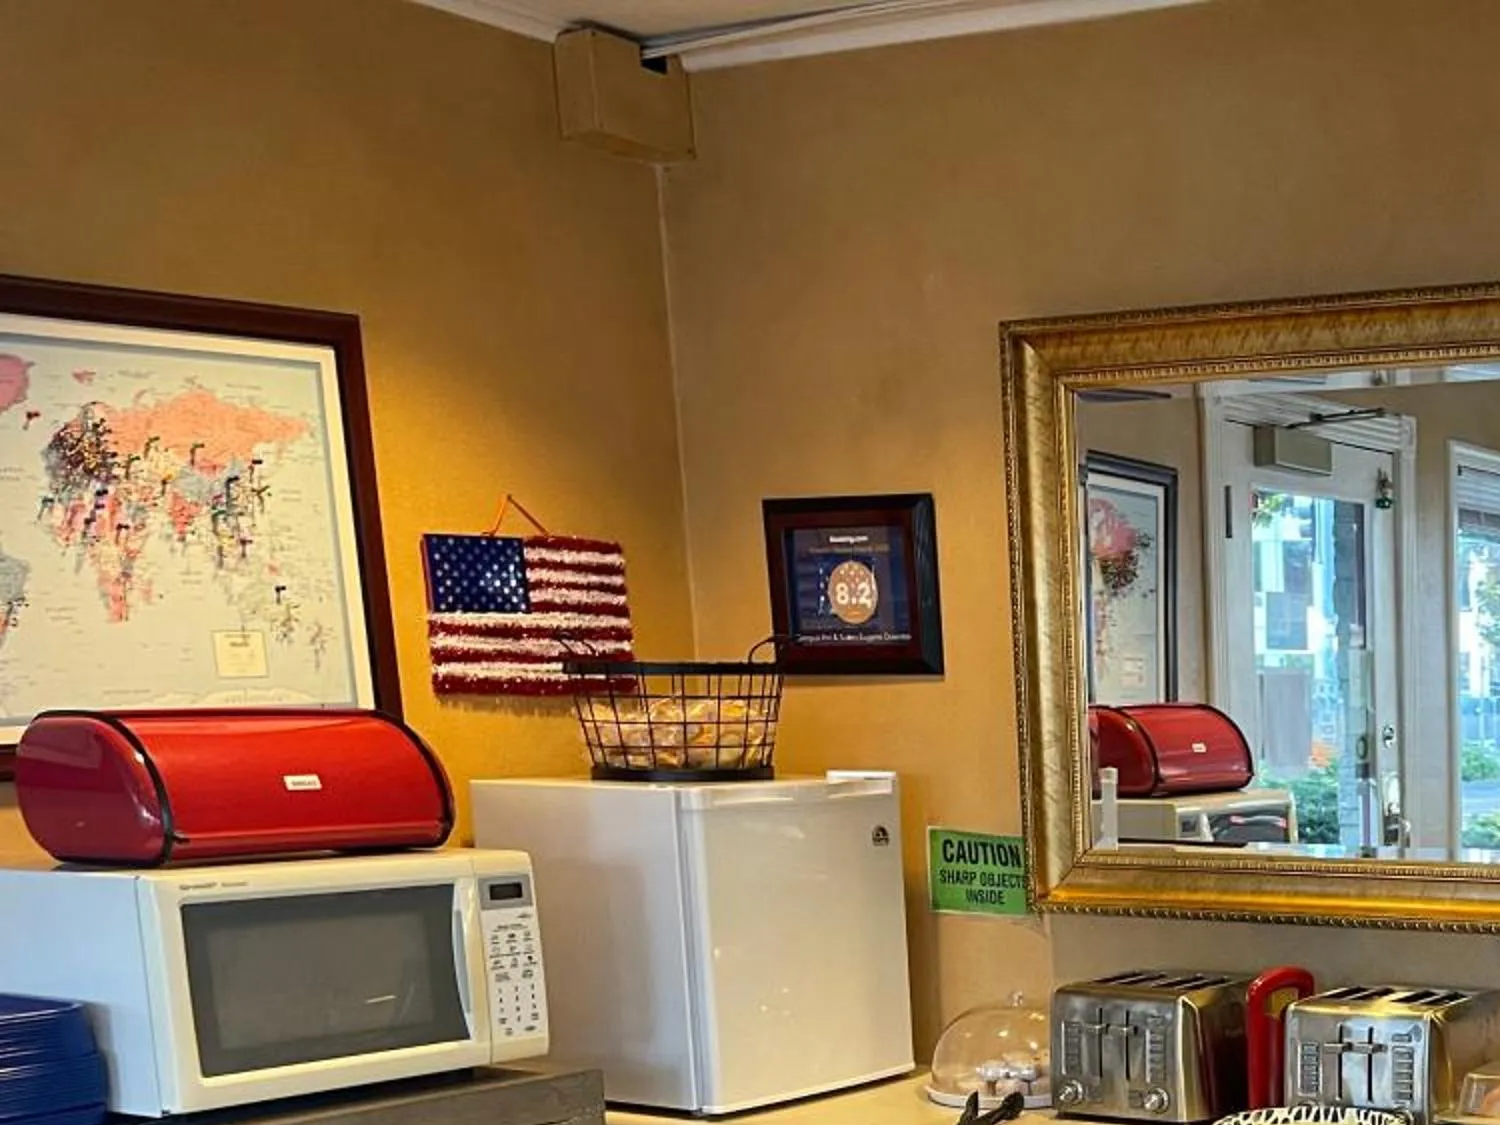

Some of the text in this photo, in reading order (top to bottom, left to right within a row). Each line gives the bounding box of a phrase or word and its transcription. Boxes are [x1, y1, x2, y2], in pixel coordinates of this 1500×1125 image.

[835, 581, 873, 608] 8.2
[942, 838, 1022, 869] CAUTION
[939, 868, 977, 885] SHARP
[966, 888, 1006, 905] INSIDE
